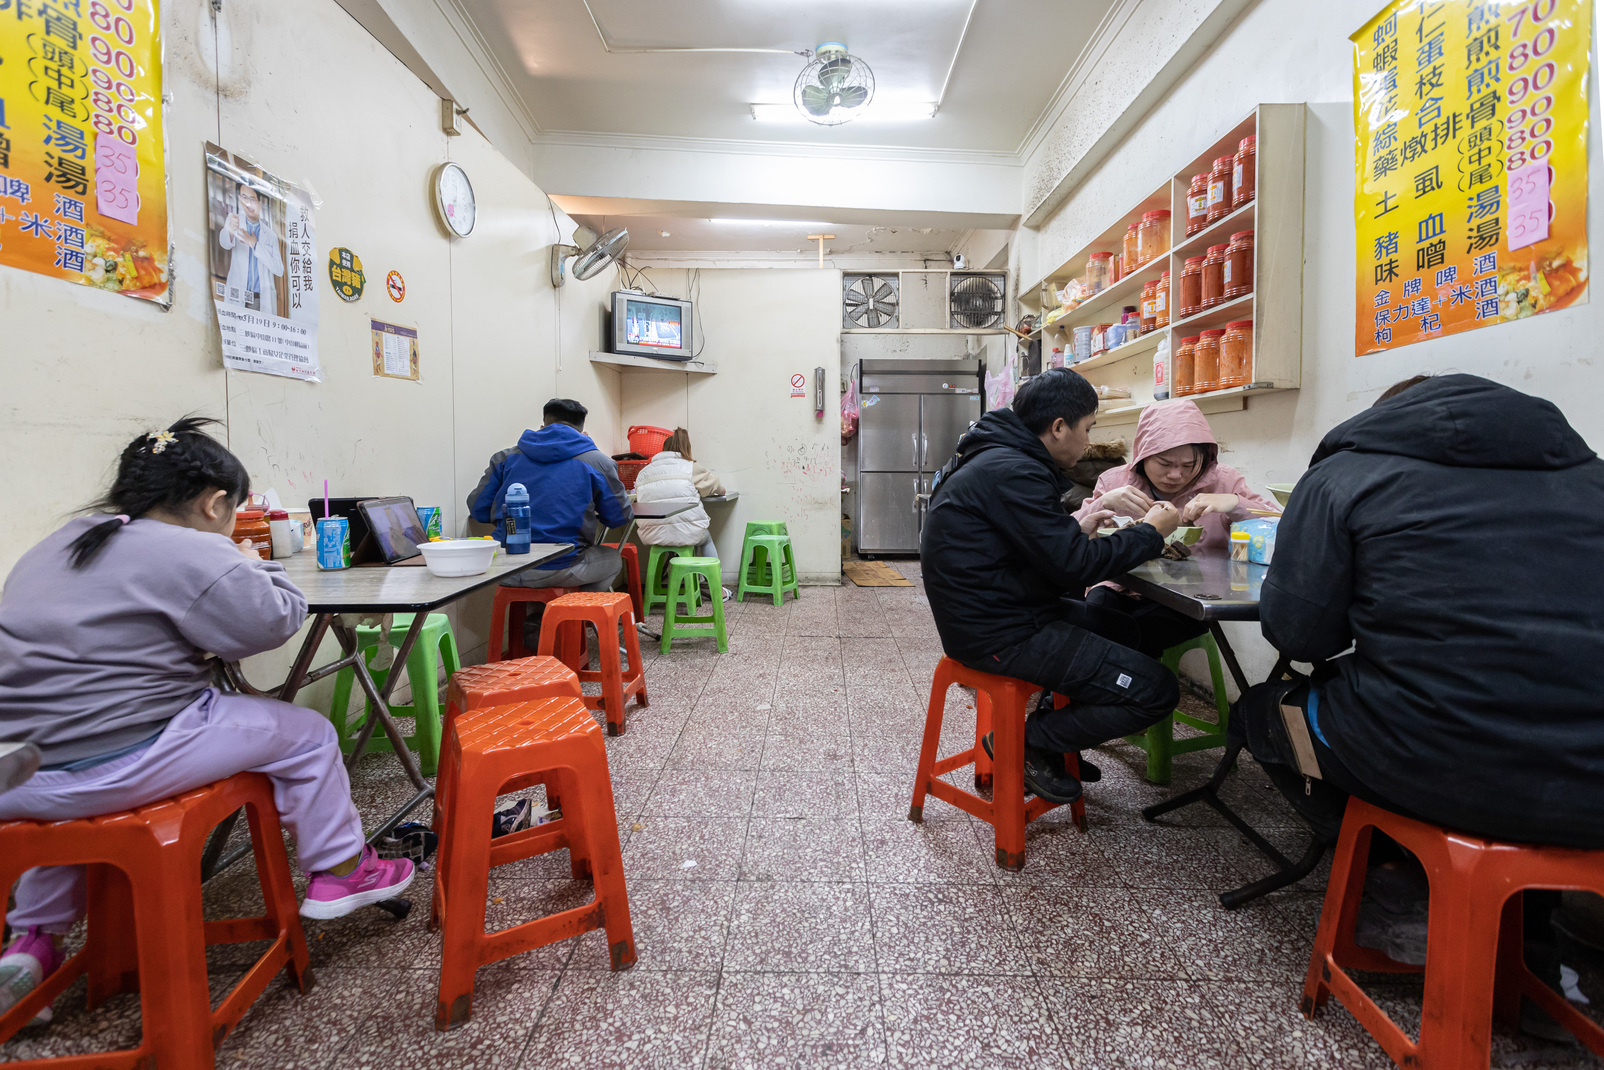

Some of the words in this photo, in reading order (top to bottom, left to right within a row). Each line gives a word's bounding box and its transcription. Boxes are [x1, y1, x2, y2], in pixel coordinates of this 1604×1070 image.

[91, 1, 134, 45] 80
[1507, 0, 1556, 38] 70
[91, 36, 134, 79] 90
[1508, 28, 1555, 71] 80
[91, 68, 135, 103] 90
[1507, 63, 1555, 105] 90
[93, 91, 136, 124] 80
[1506, 95, 1552, 130] 90
[94, 113, 137, 146] 80
[1506, 117, 1552, 151] 80
[100, 146, 131, 174] 35
[1506, 140, 1552, 172] 80
[101, 181, 131, 209] 35
[1514, 209, 1543, 239] 35
[288, 221, 302, 309] 捐血你可以
